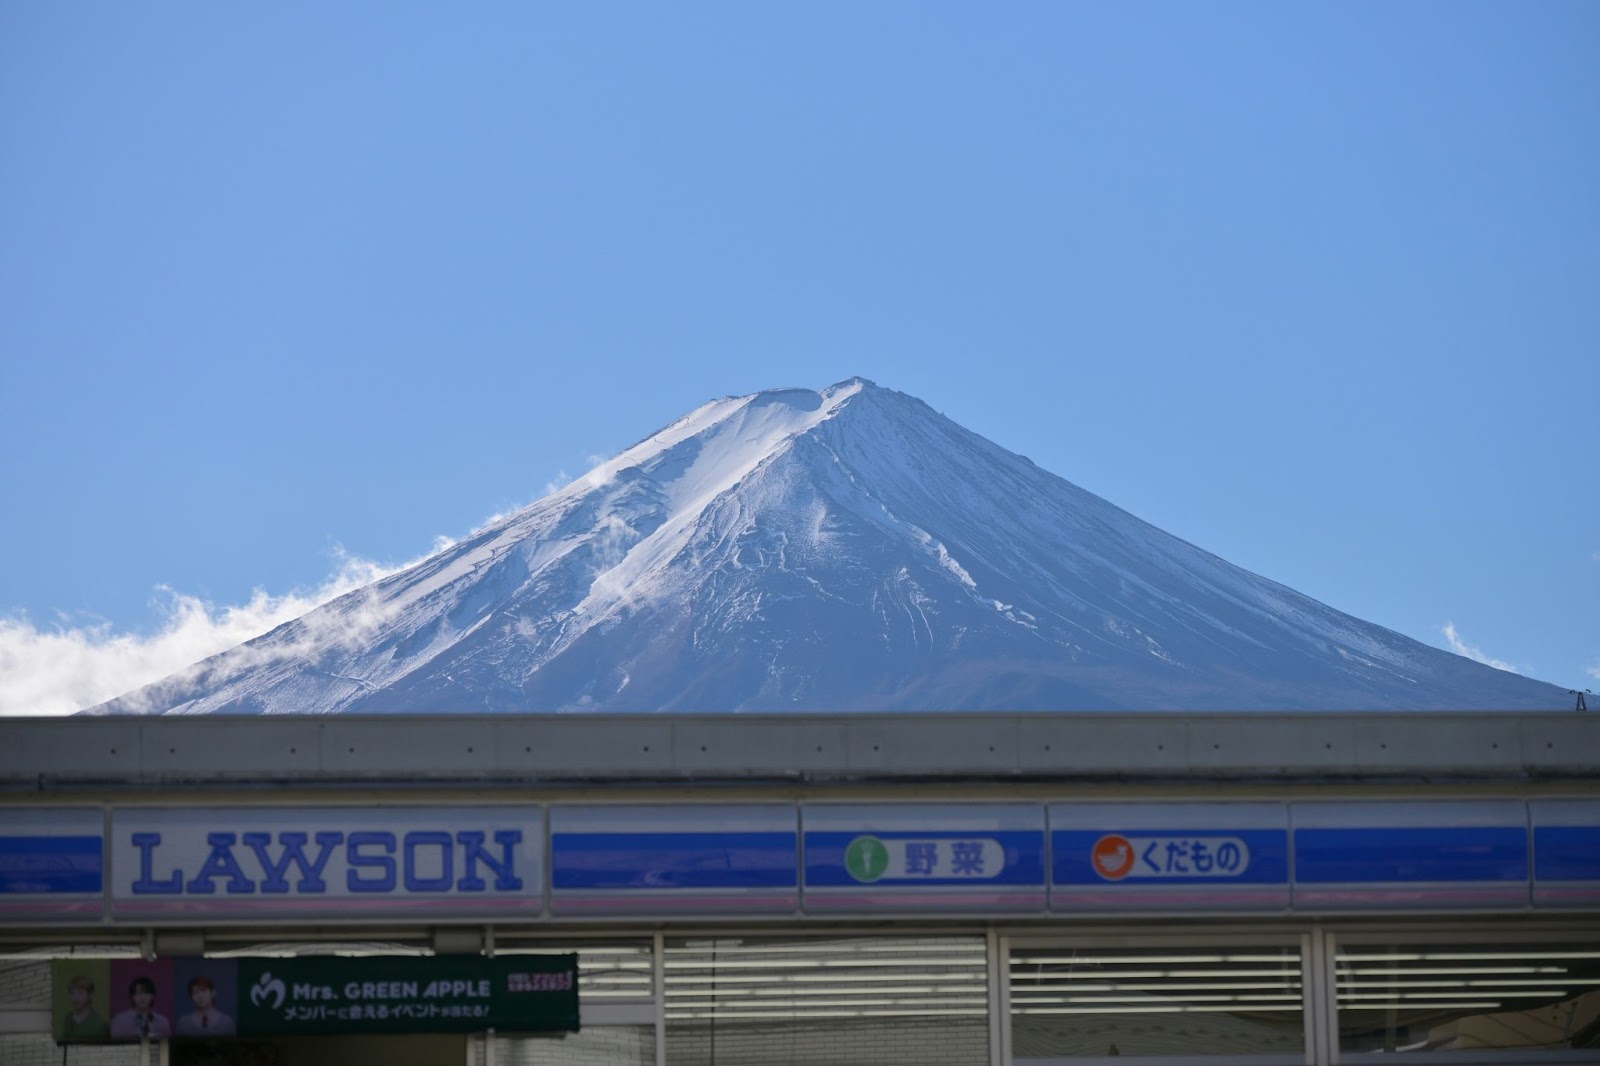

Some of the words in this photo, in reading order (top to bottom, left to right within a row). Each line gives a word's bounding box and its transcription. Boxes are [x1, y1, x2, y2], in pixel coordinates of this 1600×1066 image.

[131, 831, 523, 895] LAWSON
[905, 842, 983, 875] 野菜
[1142, 841, 1241, 873] くだもの
[292, 982, 339, 1000] Mrs.
[344, 981, 418, 999] GREEN
[422, 980, 490, 998] APPLE
